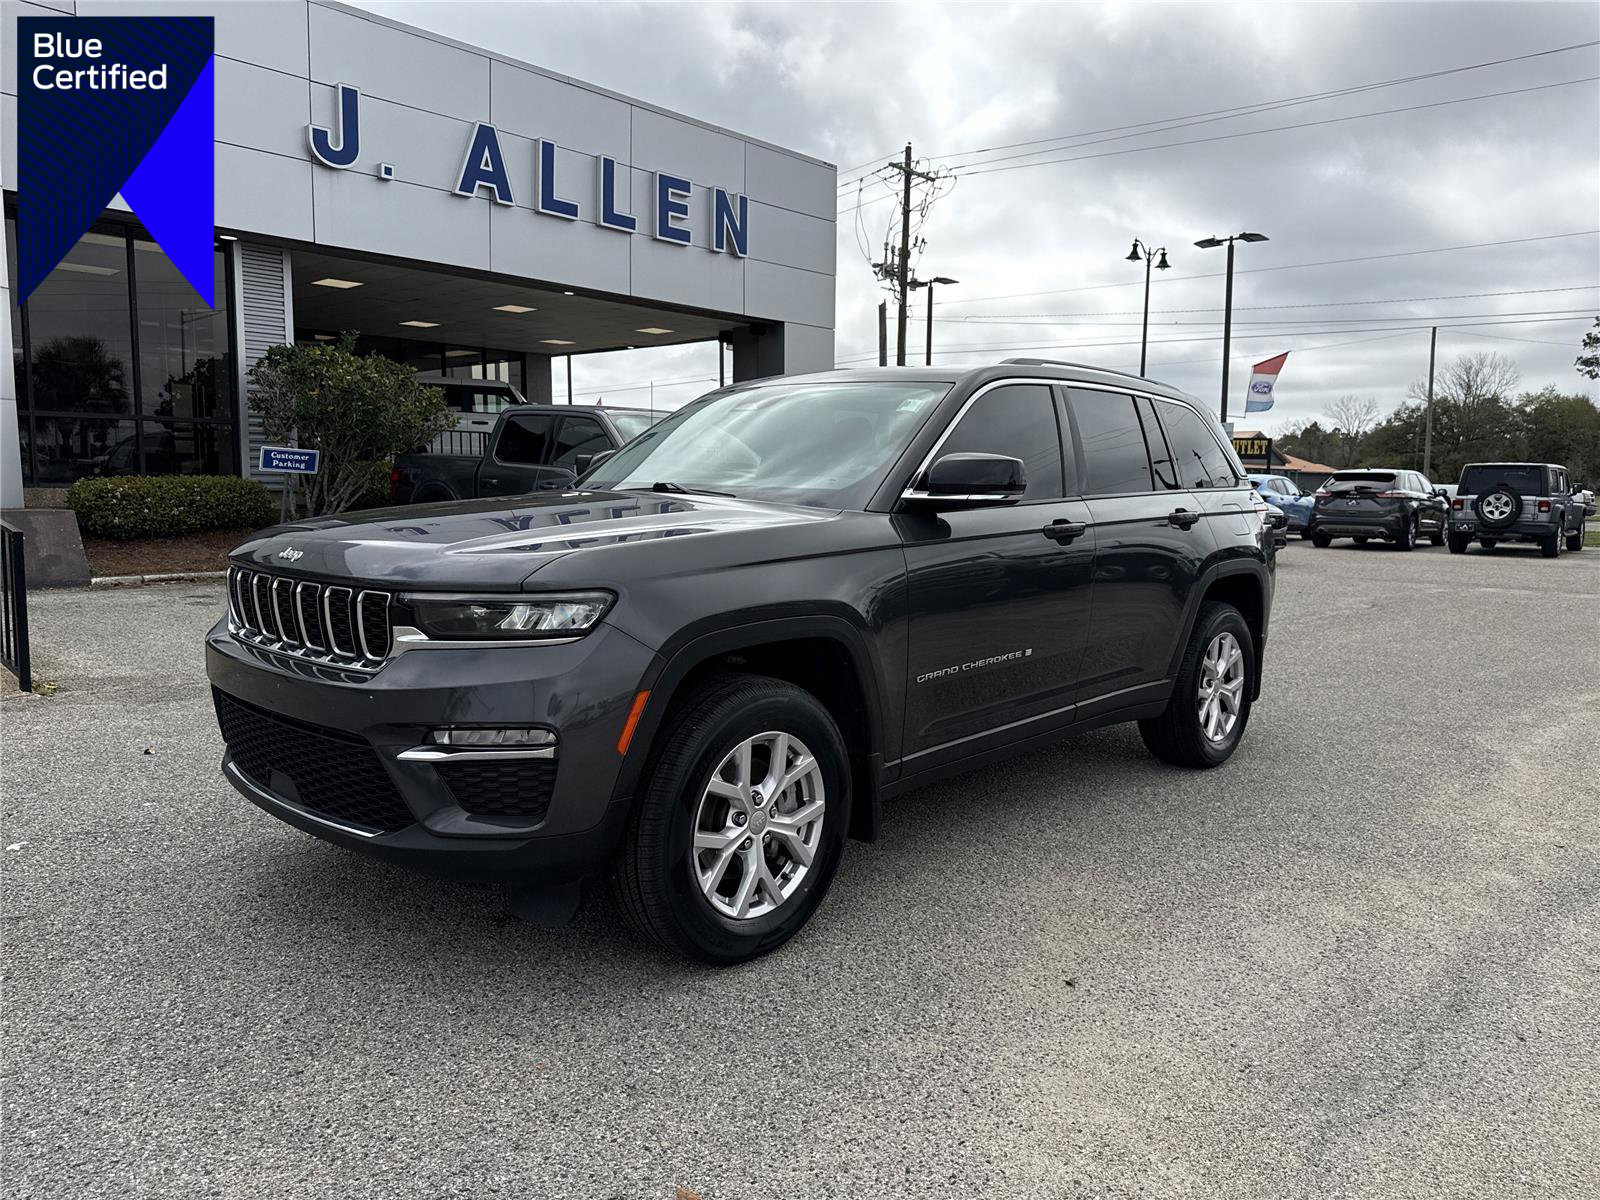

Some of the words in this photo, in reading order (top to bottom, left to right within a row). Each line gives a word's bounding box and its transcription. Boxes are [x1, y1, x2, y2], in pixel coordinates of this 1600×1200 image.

[304, 82, 395, 180] J.
[452, 120, 749, 258] ALLEN
[1252, 382, 1271, 394] Ford
[1232, 440, 1268, 455] UTLET
[271, 451, 310, 461] Customer
[272, 459, 306, 470] Parking
[278, 546, 304, 562] Jeep
[916, 665, 959, 683] GRAND
[962, 650, 1023, 671] CHEROKEE
